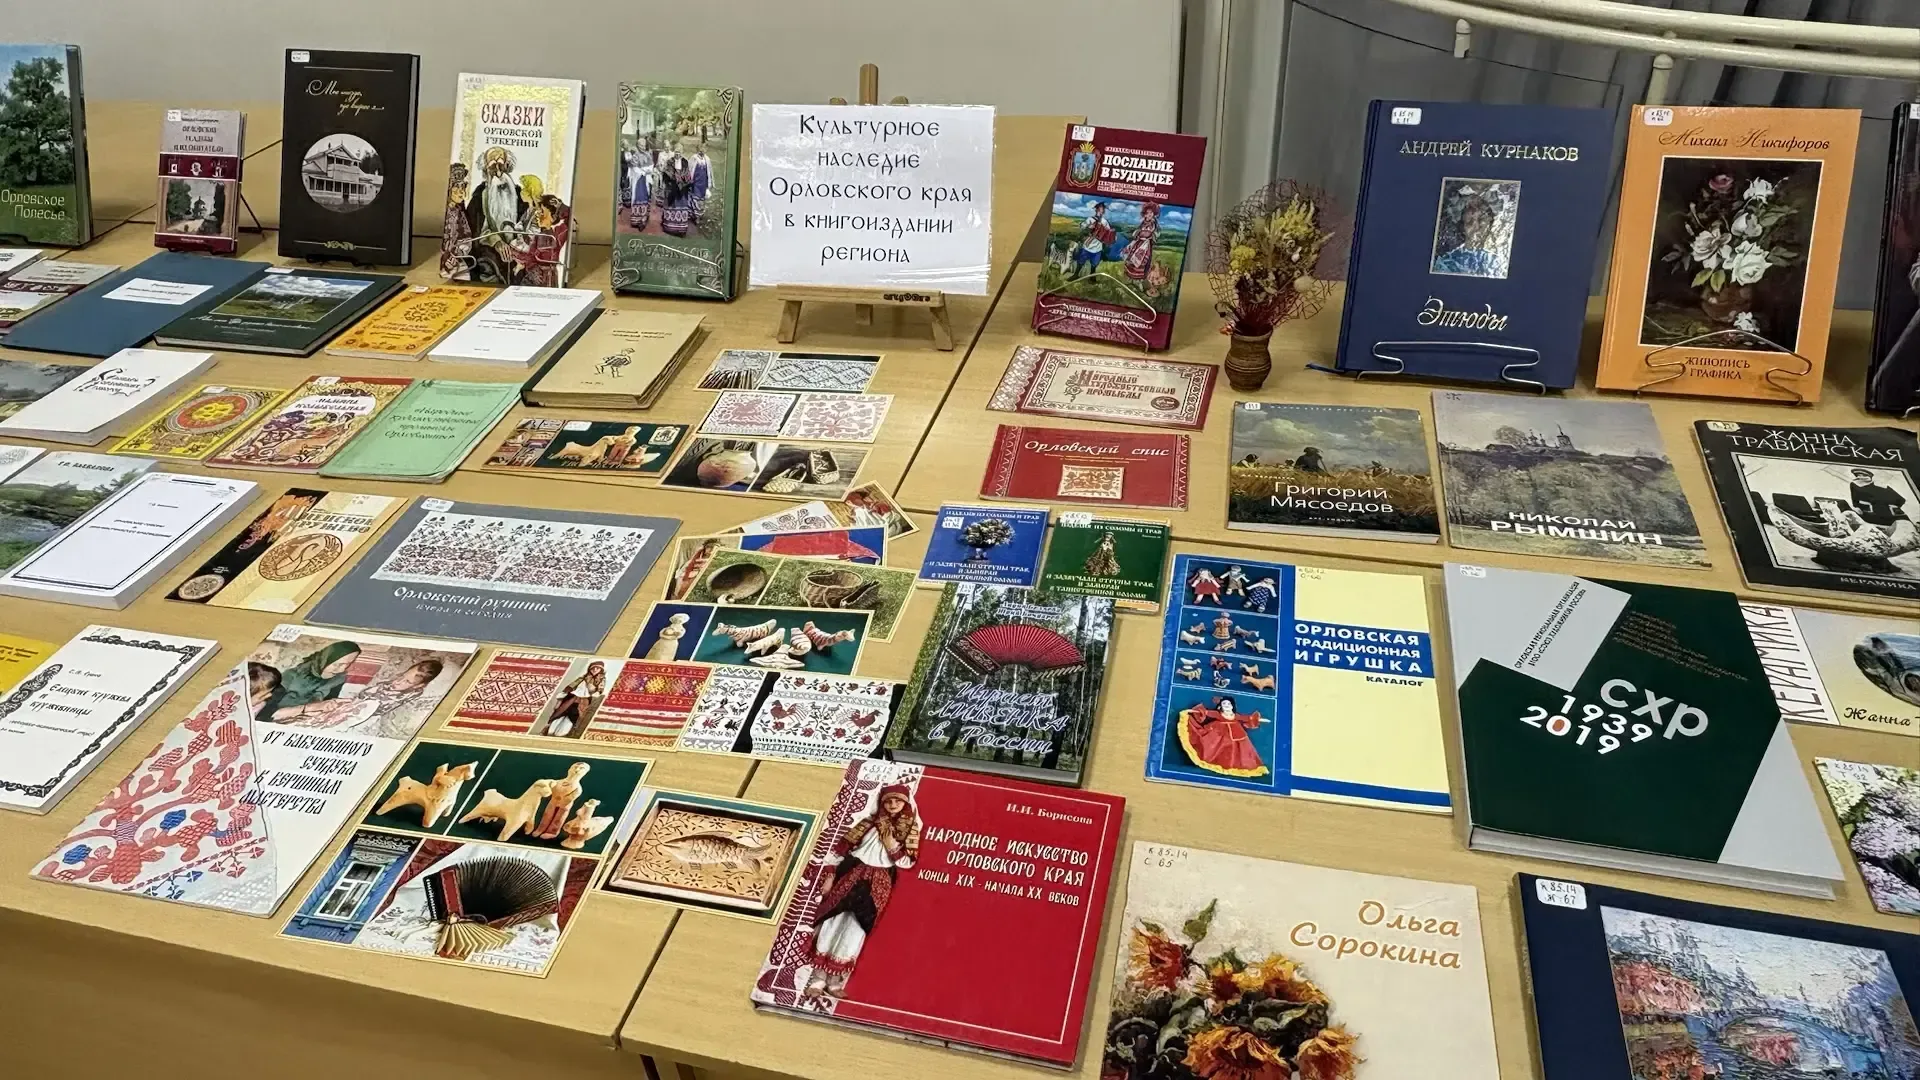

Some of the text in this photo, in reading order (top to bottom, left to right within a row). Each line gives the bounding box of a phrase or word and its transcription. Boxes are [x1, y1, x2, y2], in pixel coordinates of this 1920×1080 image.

[481, 103, 546, 127] СКАЗКИ
[484, 127, 542, 138] ОРЛОВСКОЙ
[800, 114, 940, 143] Культурное
[1658, 127, 1830, 152] Михаил Никифоров
[485, 137, 539, 148] ГУБЕРНИИ
[1399, 140, 1579, 162] АНДРЕЙ КУРНАКОВ
[818, 151, 920, 175] наследие
[1103, 154, 1174, 172] ПОСЛАНИЕ
[1100, 167, 1174, 186] В БУДУЩЕЕ
[1, 189, 65, 206] Орловское
[769, 176, 972, 209] Орловского края
[14, 204, 65, 220] Полесье
[784, 213, 954, 239] в книгоиздании
[821, 245, 910, 266] региона
[1416, 296, 1509, 331] Этюды
[1685, 356, 1751, 370] ЖИВОПИСЬ
[1689, 368, 1742, 380] ГРАФИКА
[1086, 388, 1142, 400] ПРОМЫСЛЫ
[1024, 440, 1170, 456] Орловский спис
[1726, 435, 1904, 462] ТРАВИНСКАЯ
[1764, 430, 1856, 446] ЖАННА
[1275, 482, 1388, 499] Григорий
[1271, 496, 1394, 513] Мясоедов
[1509, 512, 1636, 530] НИКОЛАЙ
[1490, 520, 1663, 545] РЫМШИН
[1840, 577, 1916, 590] КЕРАМИКА
[393, 586, 551, 613] Орловский рушник
[416, 603, 450, 614] вчера
[464, 610, 513, 620] сегодня
[1295, 623, 1420, 646] ОРЛОВСКАЯ
[1294, 637, 1421, 659] ТРАДИЦИОННАЯ
[1295, 650, 1423, 673] ИГРУШКА
[1366, 675, 1424, 687] КАТАЛОГ
[955, 681, 1059, 708] Играет
[928, 700, 1070, 732] ЛИВЕНКА
[1561, 694, 1653, 743] 1939
[1843, 707, 1911, 727] Жанна
[928, 720, 1054, 754] в России
[1519, 705, 1621, 755] 2019
[263, 731, 373, 757] ОТ БАБУШКИНОГО
[300, 755, 358, 776] СУНДУКА
[254, 770, 342, 796] К ВЕРШИНАМ
[239, 789, 327, 815] МАСТЕРСТВА
[1006, 803, 1093, 825] И.И. Борисова
[925, 825, 1089, 867] НАРОДНОЕ ИСКУССТВО
[1158, 848, 1188, 860] 85.14
[946, 849, 1085, 887] ОРЛОВСКОГО КРАЯ
[917, 868, 950, 885] КОНЦА
[955, 873, 974, 889] XIX
[984, 879, 1024, 898] НАЧАЛА
[1027, 886, 1043, 900] XX
[1048, 890, 1080, 906] ВЕКОВ
[1549, 882, 1577, 895] 85.14
[1358, 900, 1461, 938] Ольга
[1289, 922, 1461, 970] Сорокина
